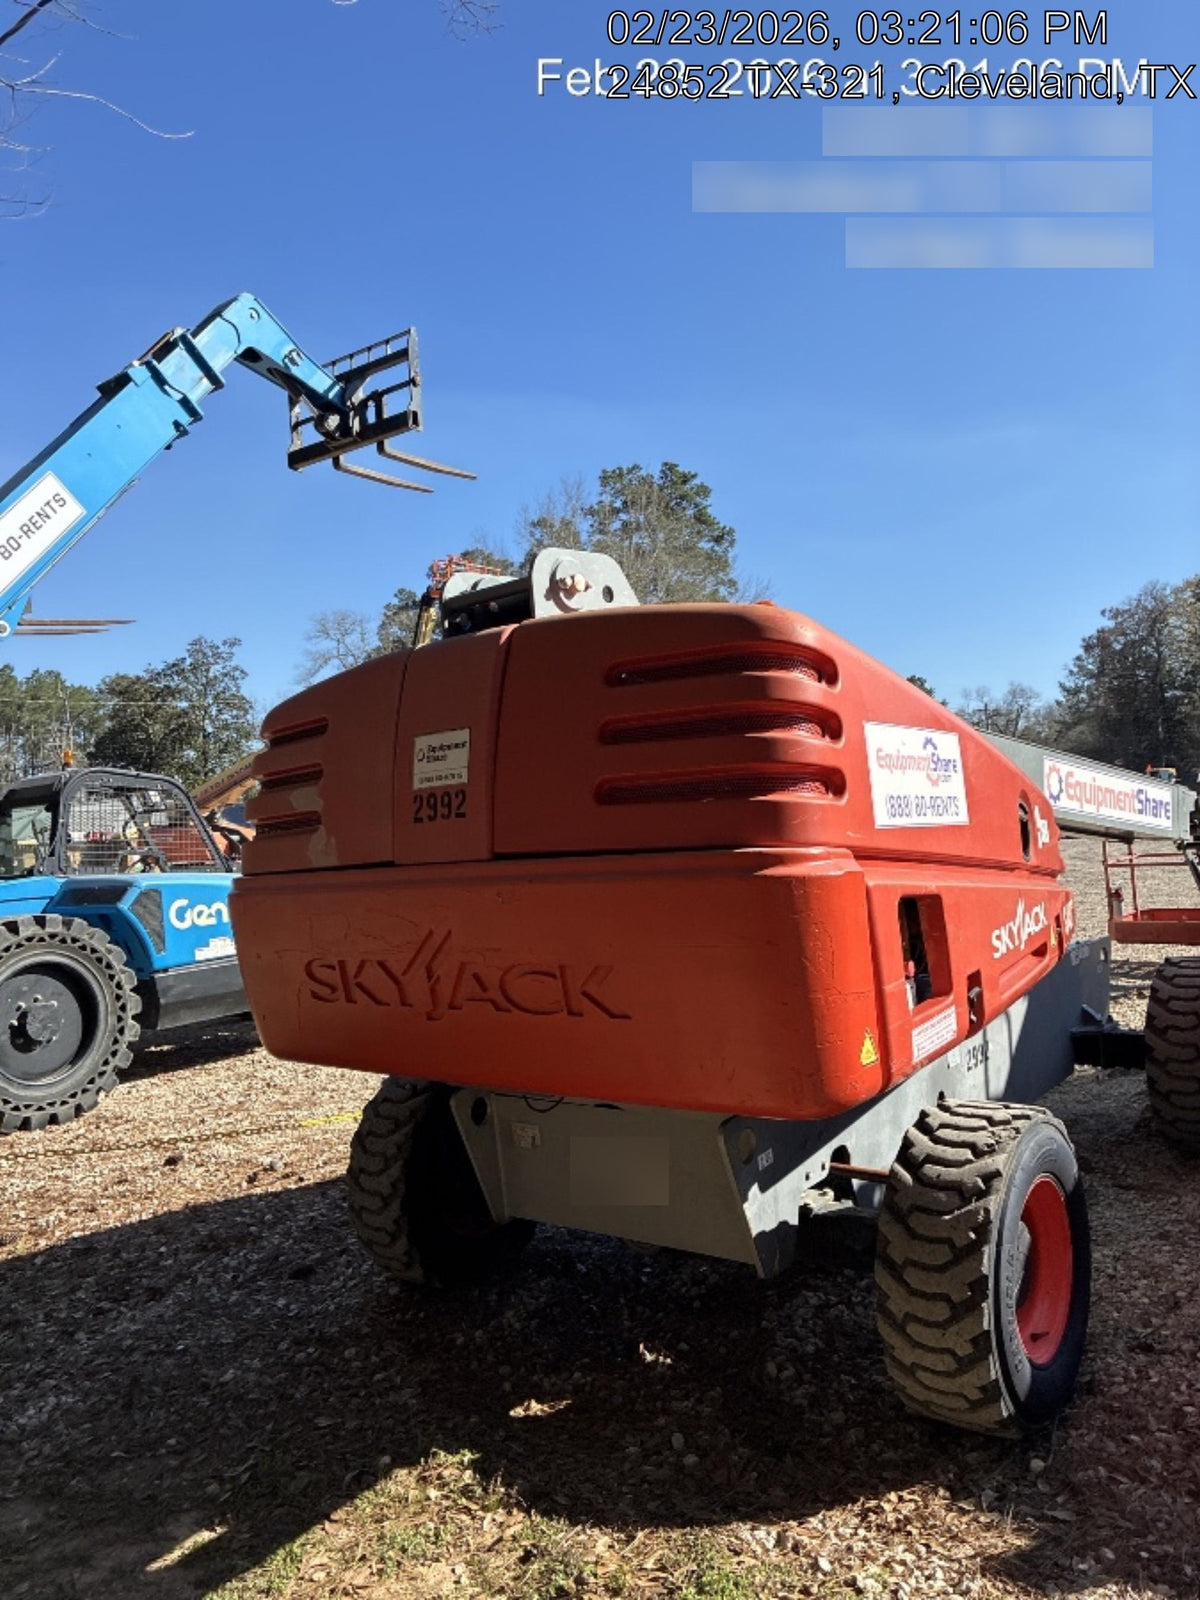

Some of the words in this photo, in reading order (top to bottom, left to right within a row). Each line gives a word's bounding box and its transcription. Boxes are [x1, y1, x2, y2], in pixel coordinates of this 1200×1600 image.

[412, 789, 467, 824] 2992
[1064, 770, 1171, 820] EquipmentShare
[991, 896, 1049, 960] SKYJACK
[304, 928, 632, 1022] SKYJACK
